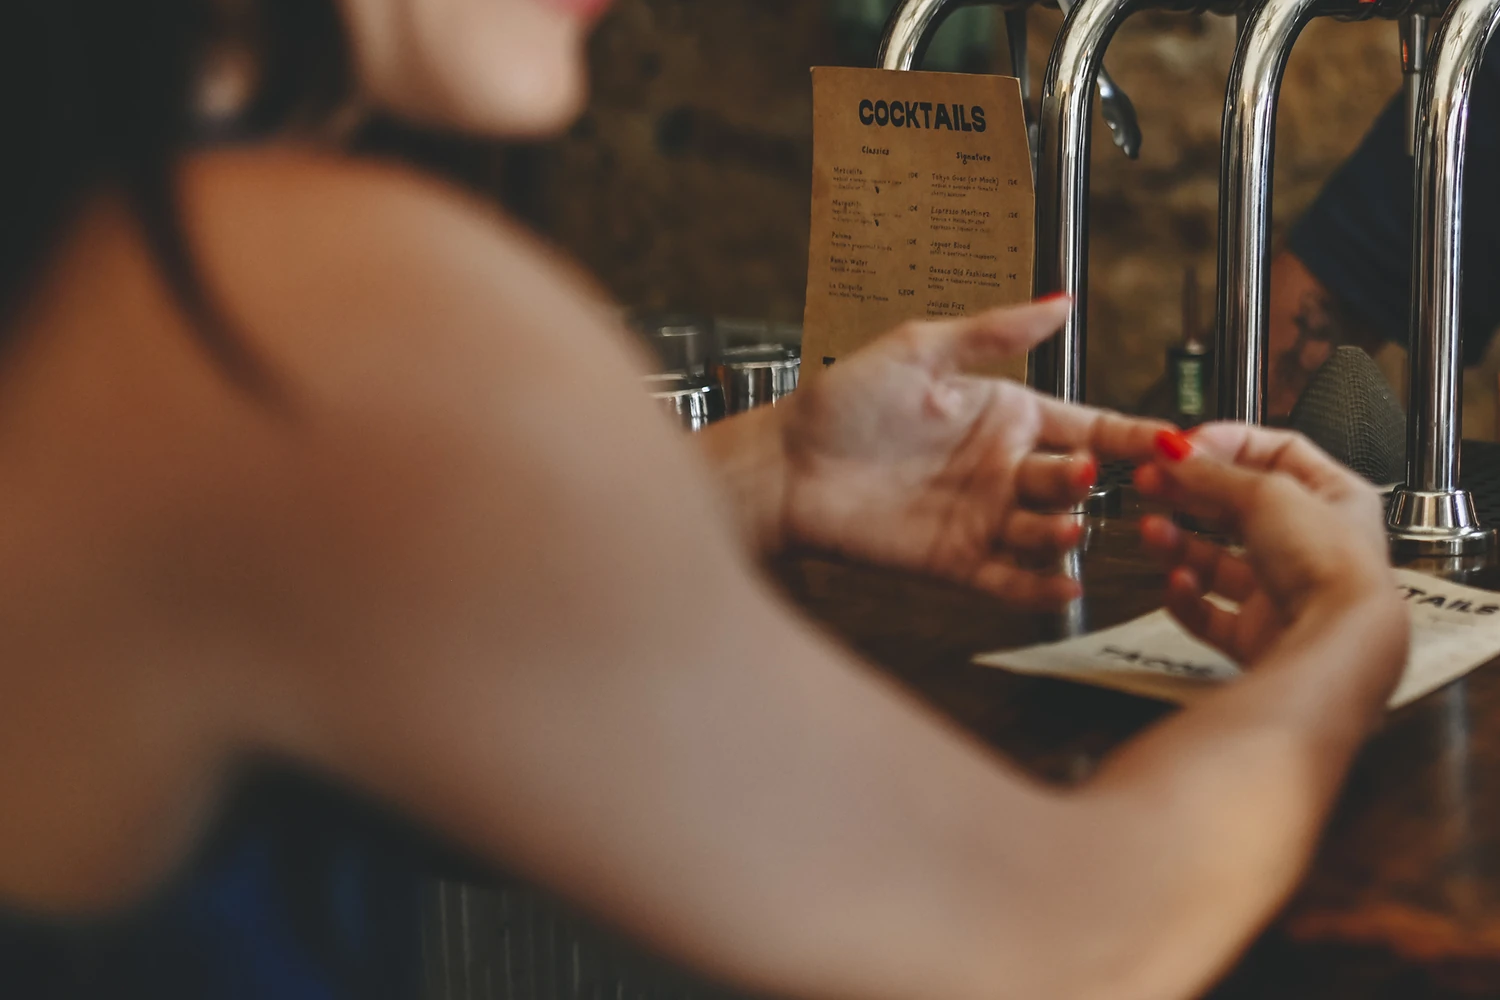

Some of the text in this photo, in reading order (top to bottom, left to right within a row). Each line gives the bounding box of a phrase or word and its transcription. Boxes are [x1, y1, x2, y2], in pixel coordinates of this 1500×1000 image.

[858, 99, 987, 133] COCKTAILS
[861, 145, 890, 156] Classics
[956, 151, 992, 166] Signature
[931, 172, 950, 184] Tokyo
[930, 206, 959, 217] Espresso
[930, 241, 952, 252] Jaguar
[953, 241, 971, 251] Blood
[929, 265, 951, 276] Oaxaca
[952, 268, 964, 277] Old
[965, 268, 998, 280] Fashioned
[951, 301, 965, 311] Fizz
